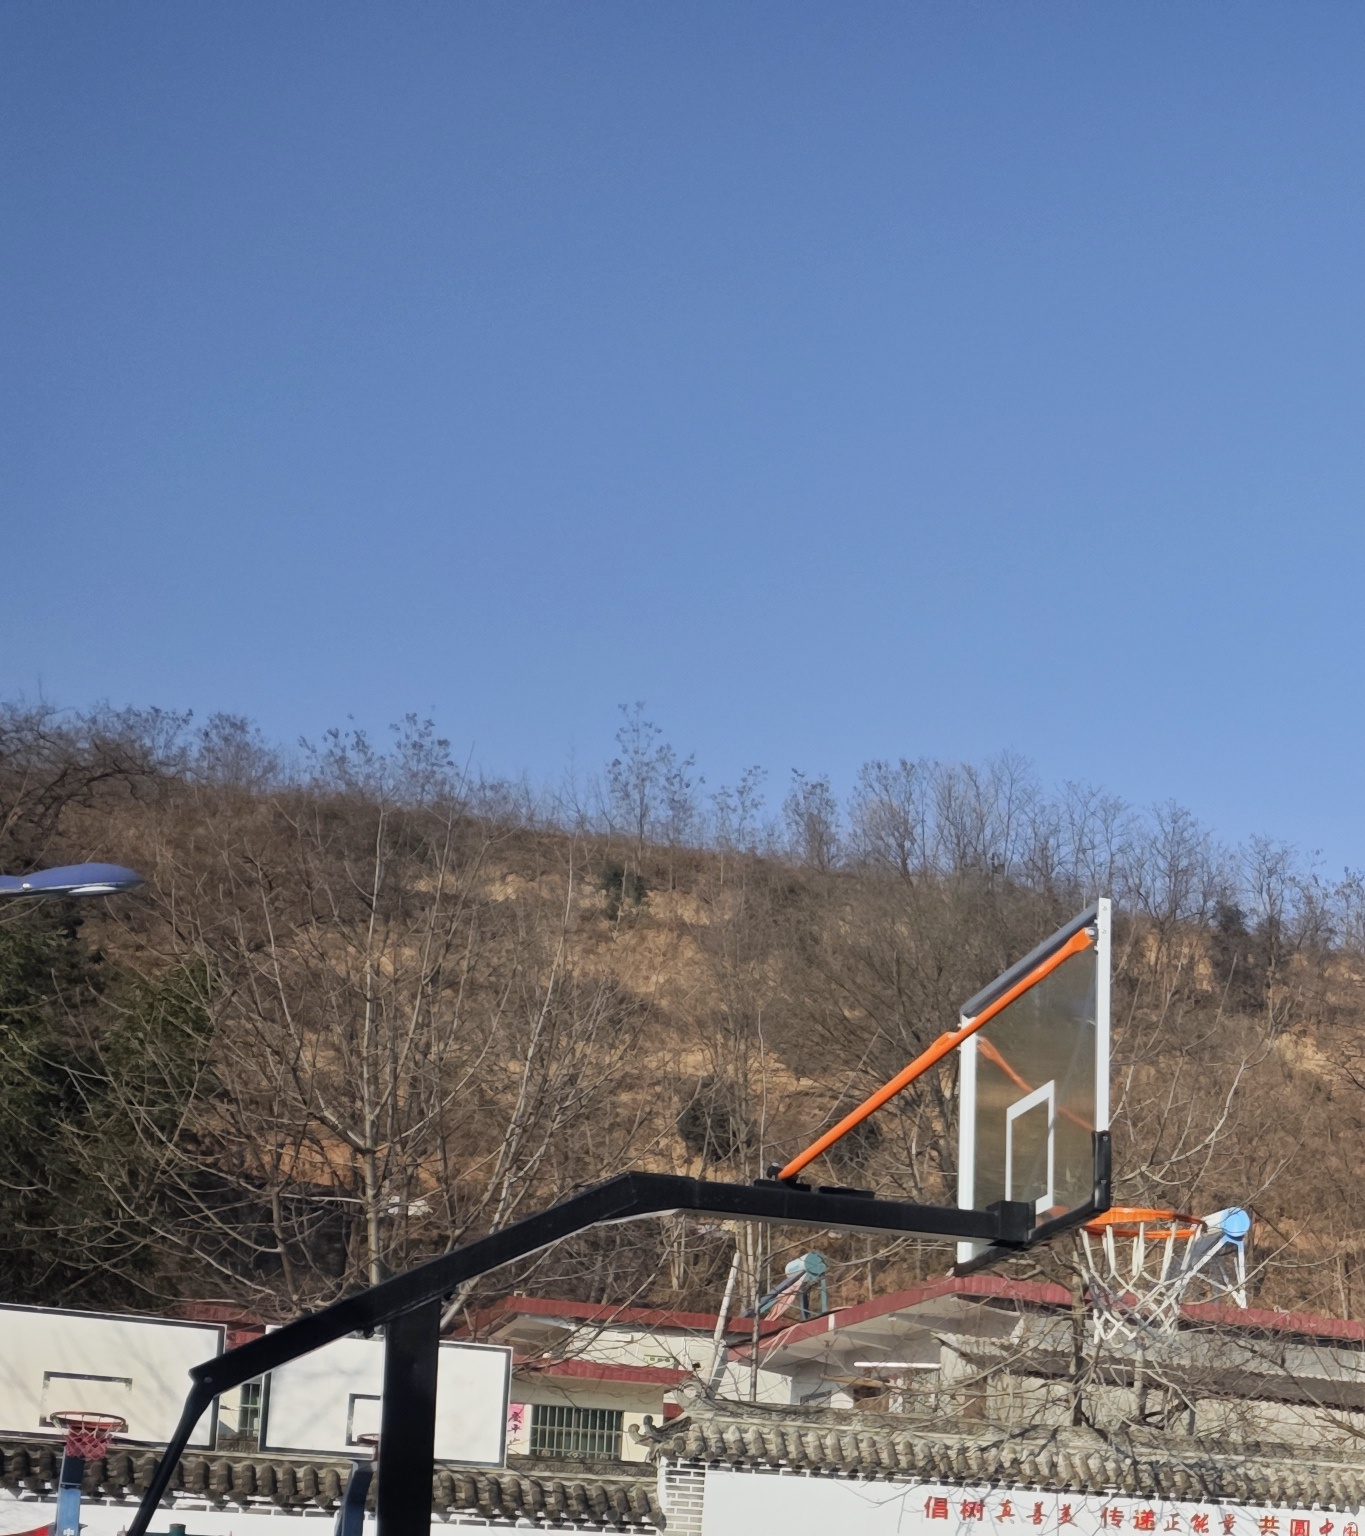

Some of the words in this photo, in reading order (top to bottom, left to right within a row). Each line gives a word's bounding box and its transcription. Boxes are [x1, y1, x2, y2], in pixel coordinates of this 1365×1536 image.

[1101, 1507, 1236, 1536] 传递正能量
